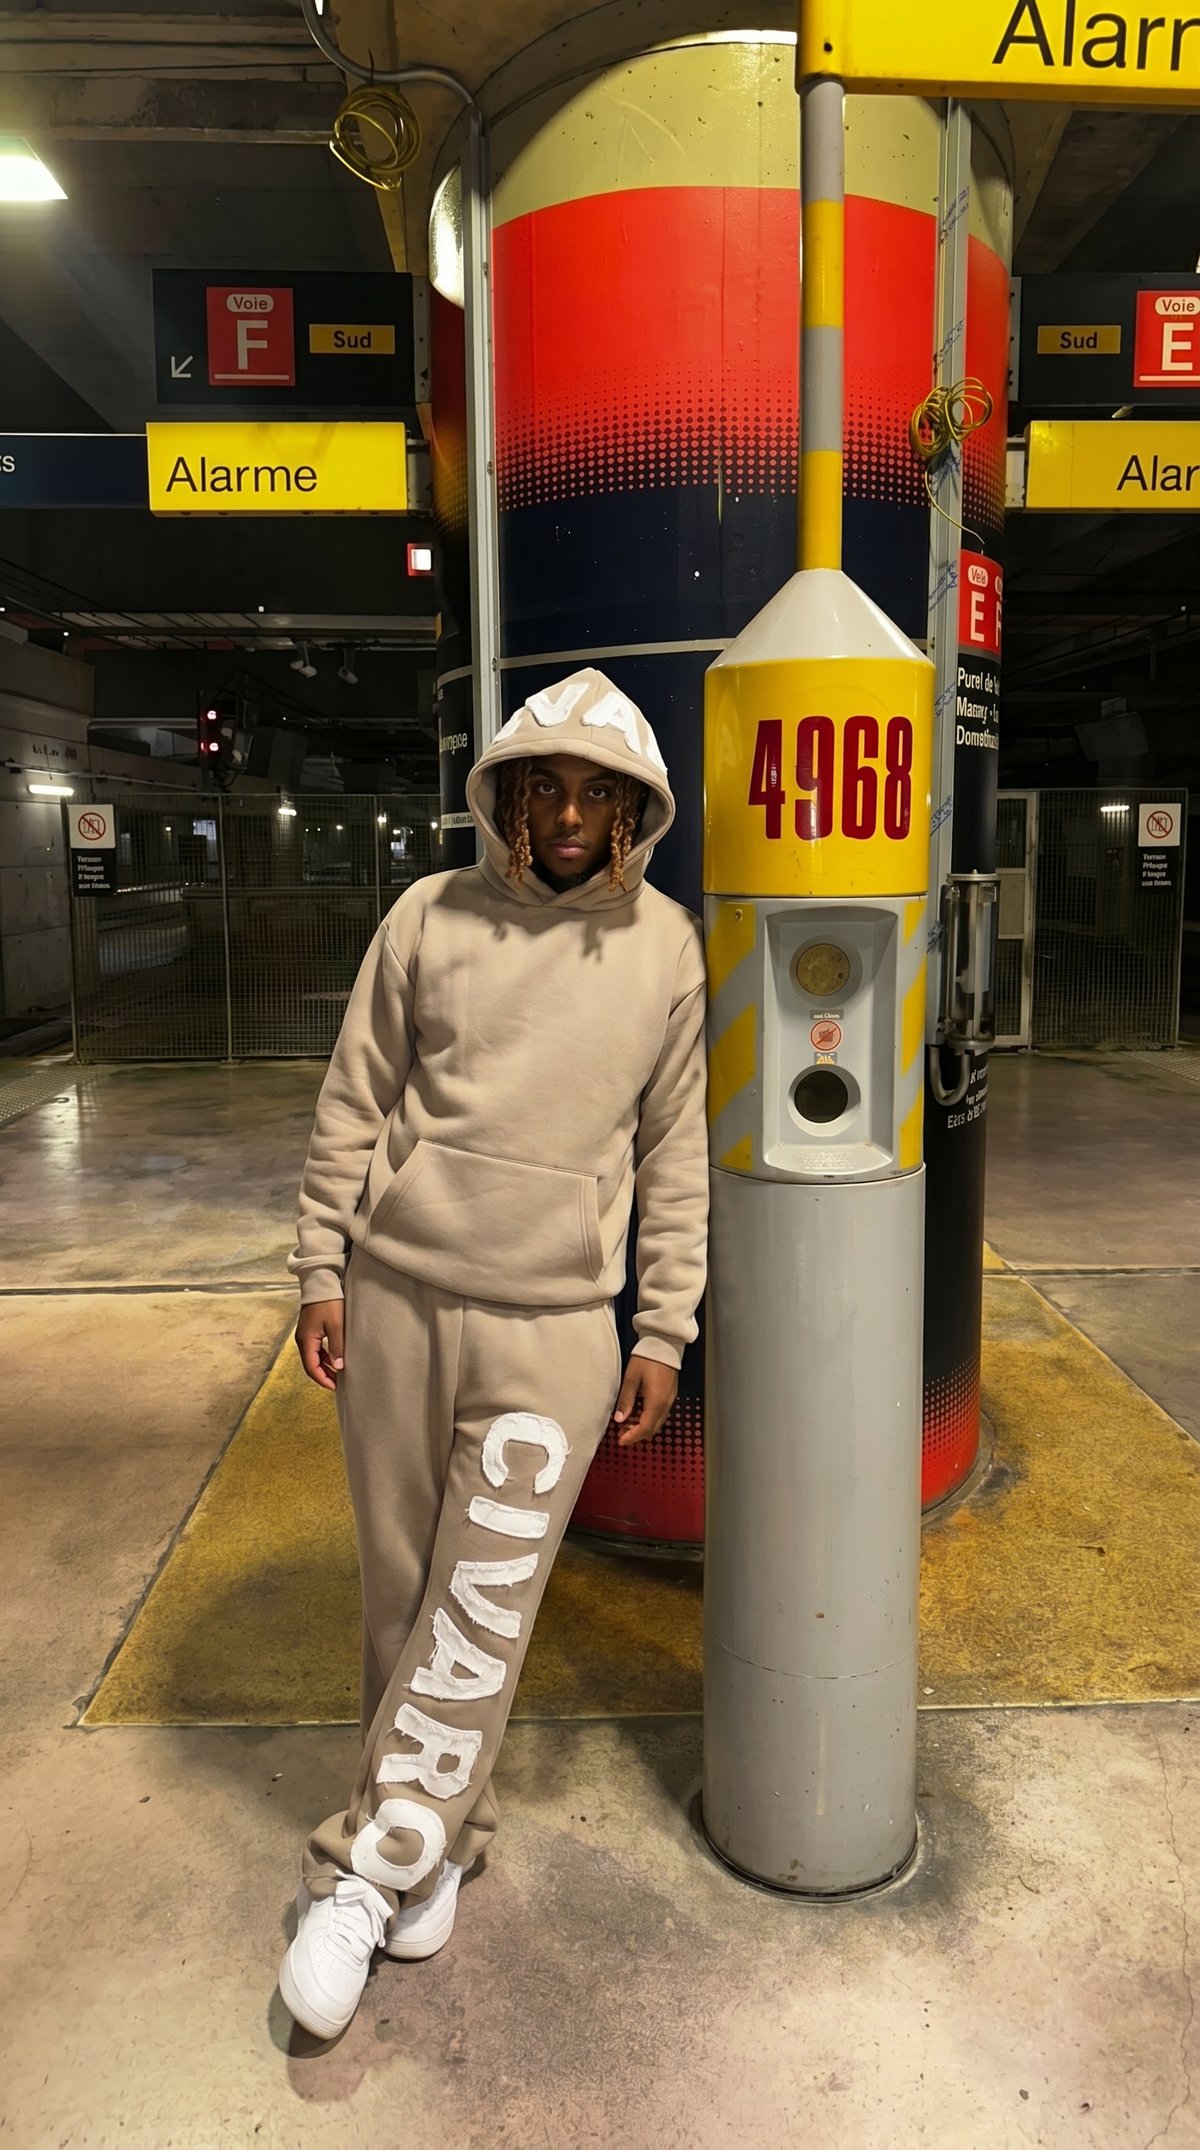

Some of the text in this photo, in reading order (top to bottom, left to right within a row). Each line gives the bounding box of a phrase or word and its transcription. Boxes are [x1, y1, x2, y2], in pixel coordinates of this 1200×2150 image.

[233, 297, 268, 311] Voie
[1162, 299, 1195, 313] Voie
[236, 320, 268, 370] F
[333, 331, 372, 349] Sud
[1059, 331, 1098, 349] Sud
[1162, 322, 1194, 371] E
[166, 456, 318, 492] Alarme
[970, 590, 985, 642] E
[748, 715, 913, 841] 4968
[350, 1411, 572, 1891] CIVARO
